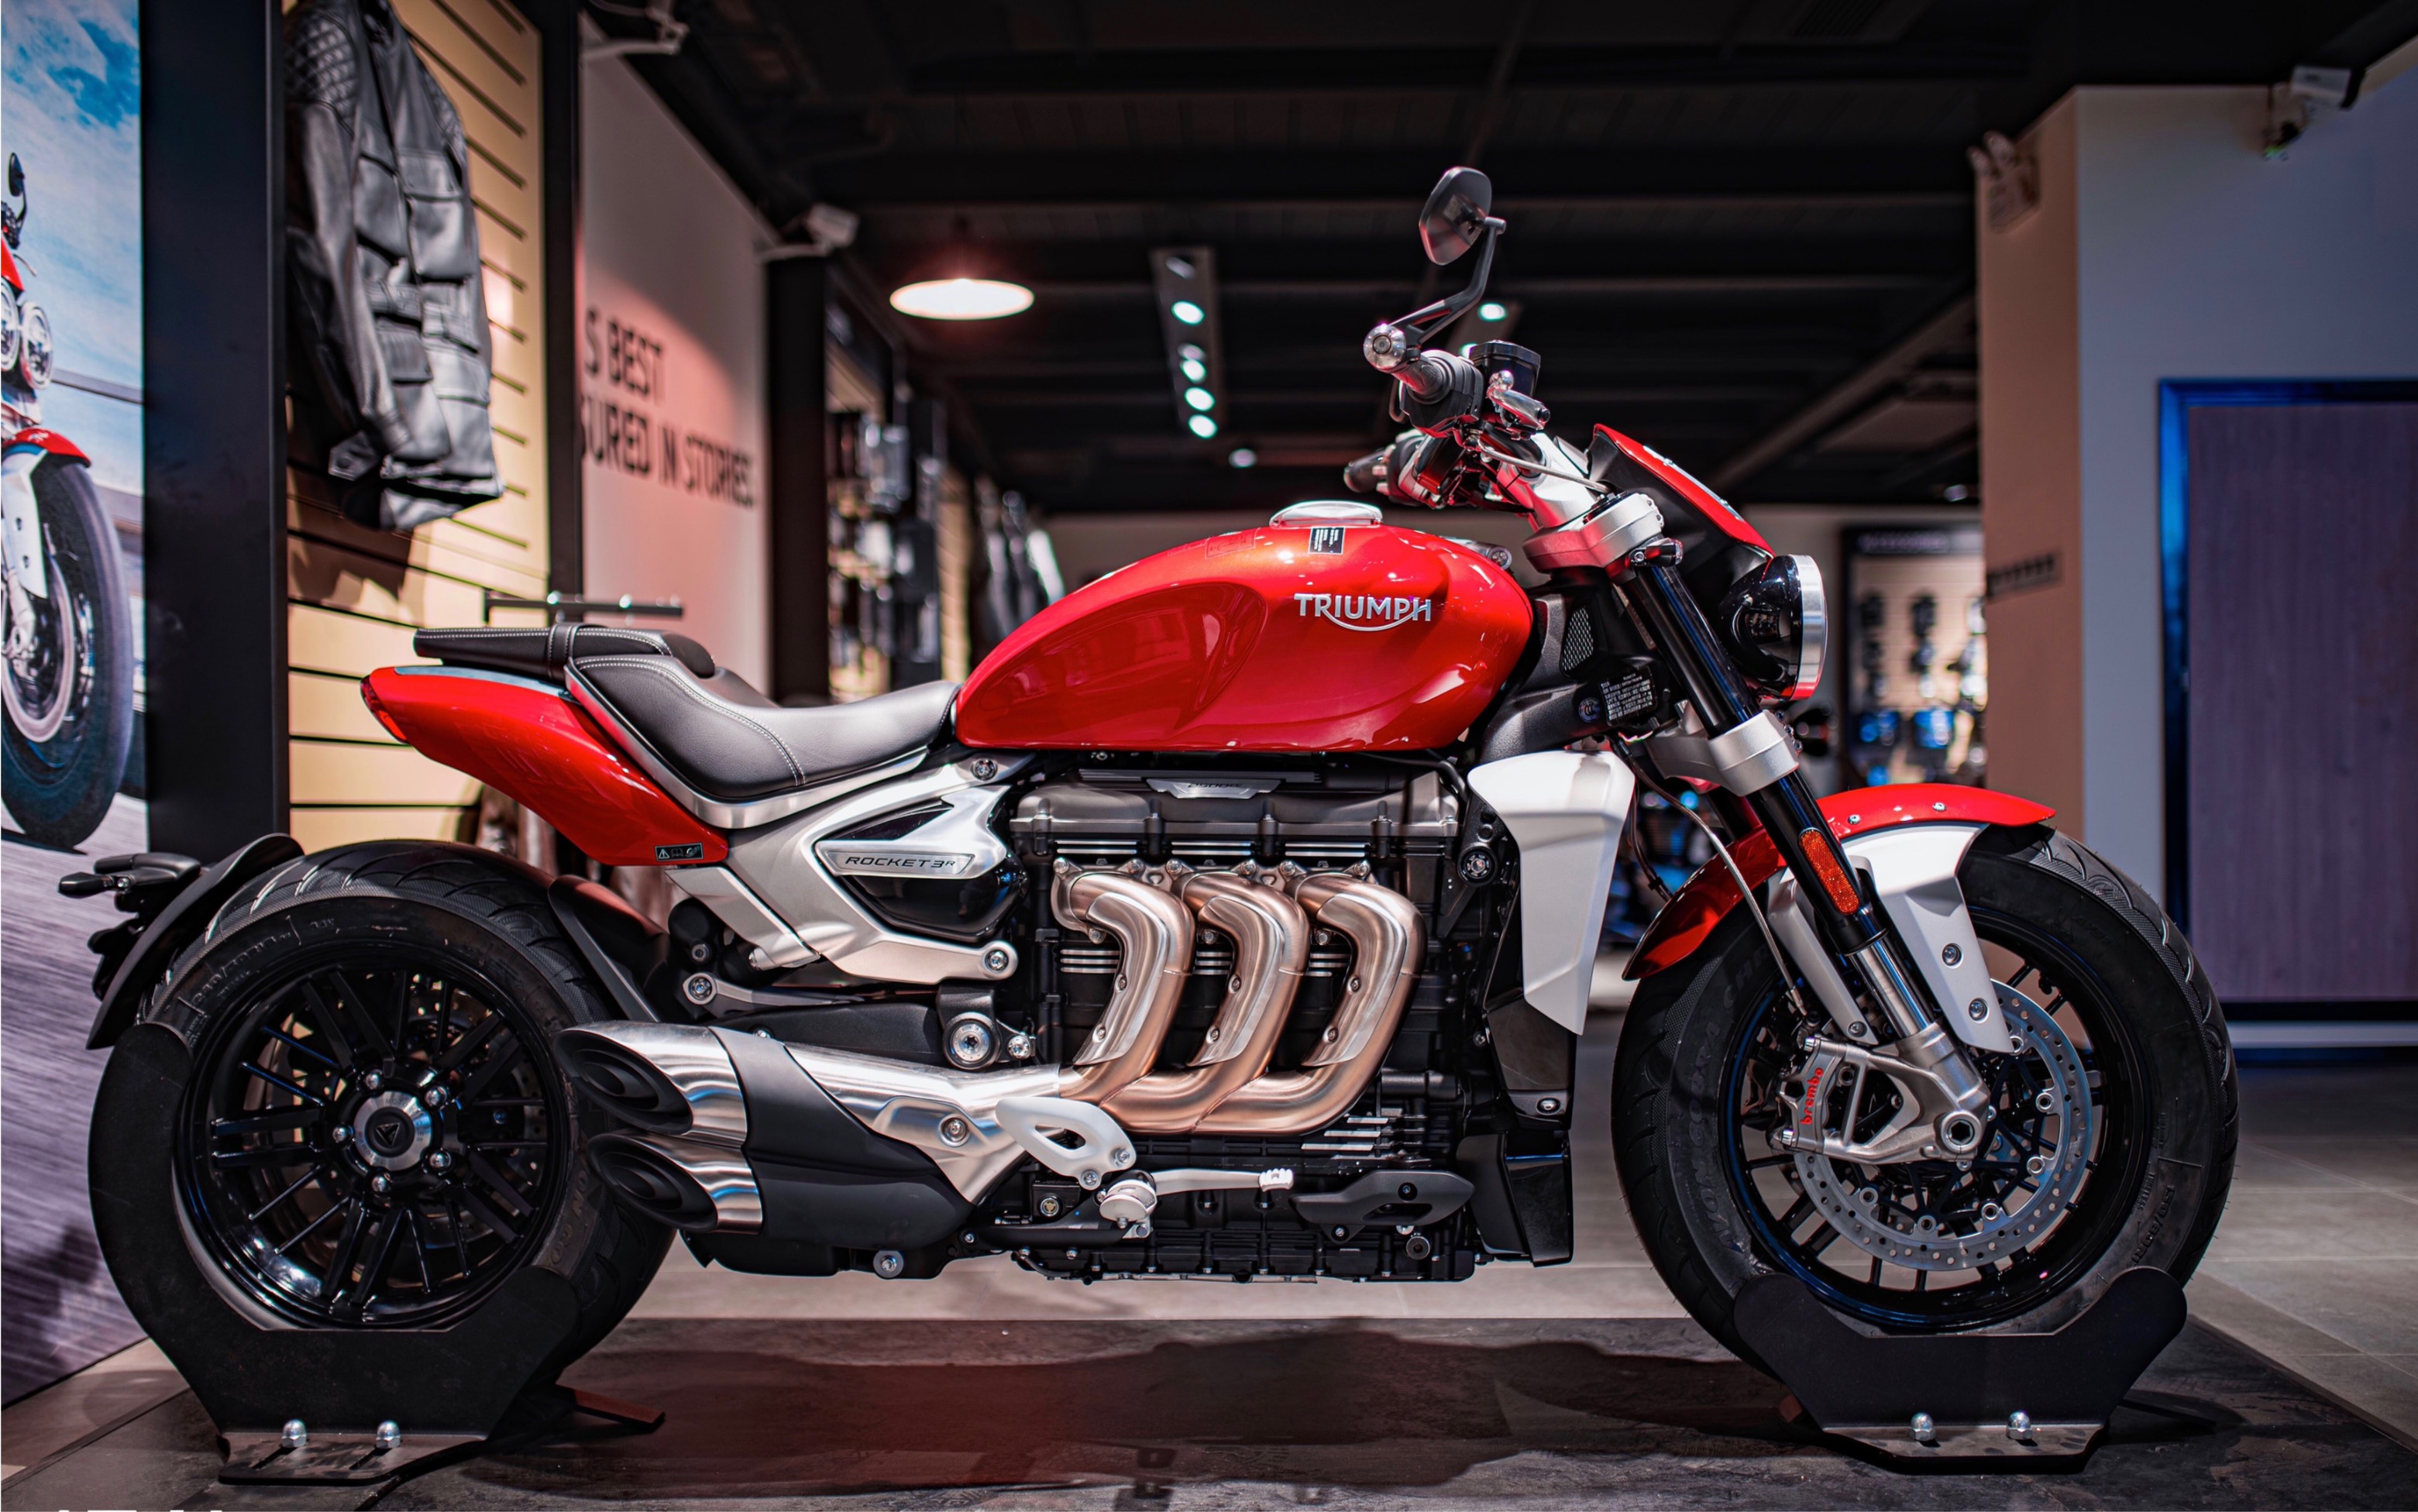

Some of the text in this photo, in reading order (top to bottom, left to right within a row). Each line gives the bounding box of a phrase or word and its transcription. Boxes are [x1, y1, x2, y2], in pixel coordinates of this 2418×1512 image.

[608, 319, 664, 404] BEST
[658, 426, 677, 488] IN
[1294, 593, 1432, 632] TRIUMPH
[1799, 1067, 1825, 1125] brembo
